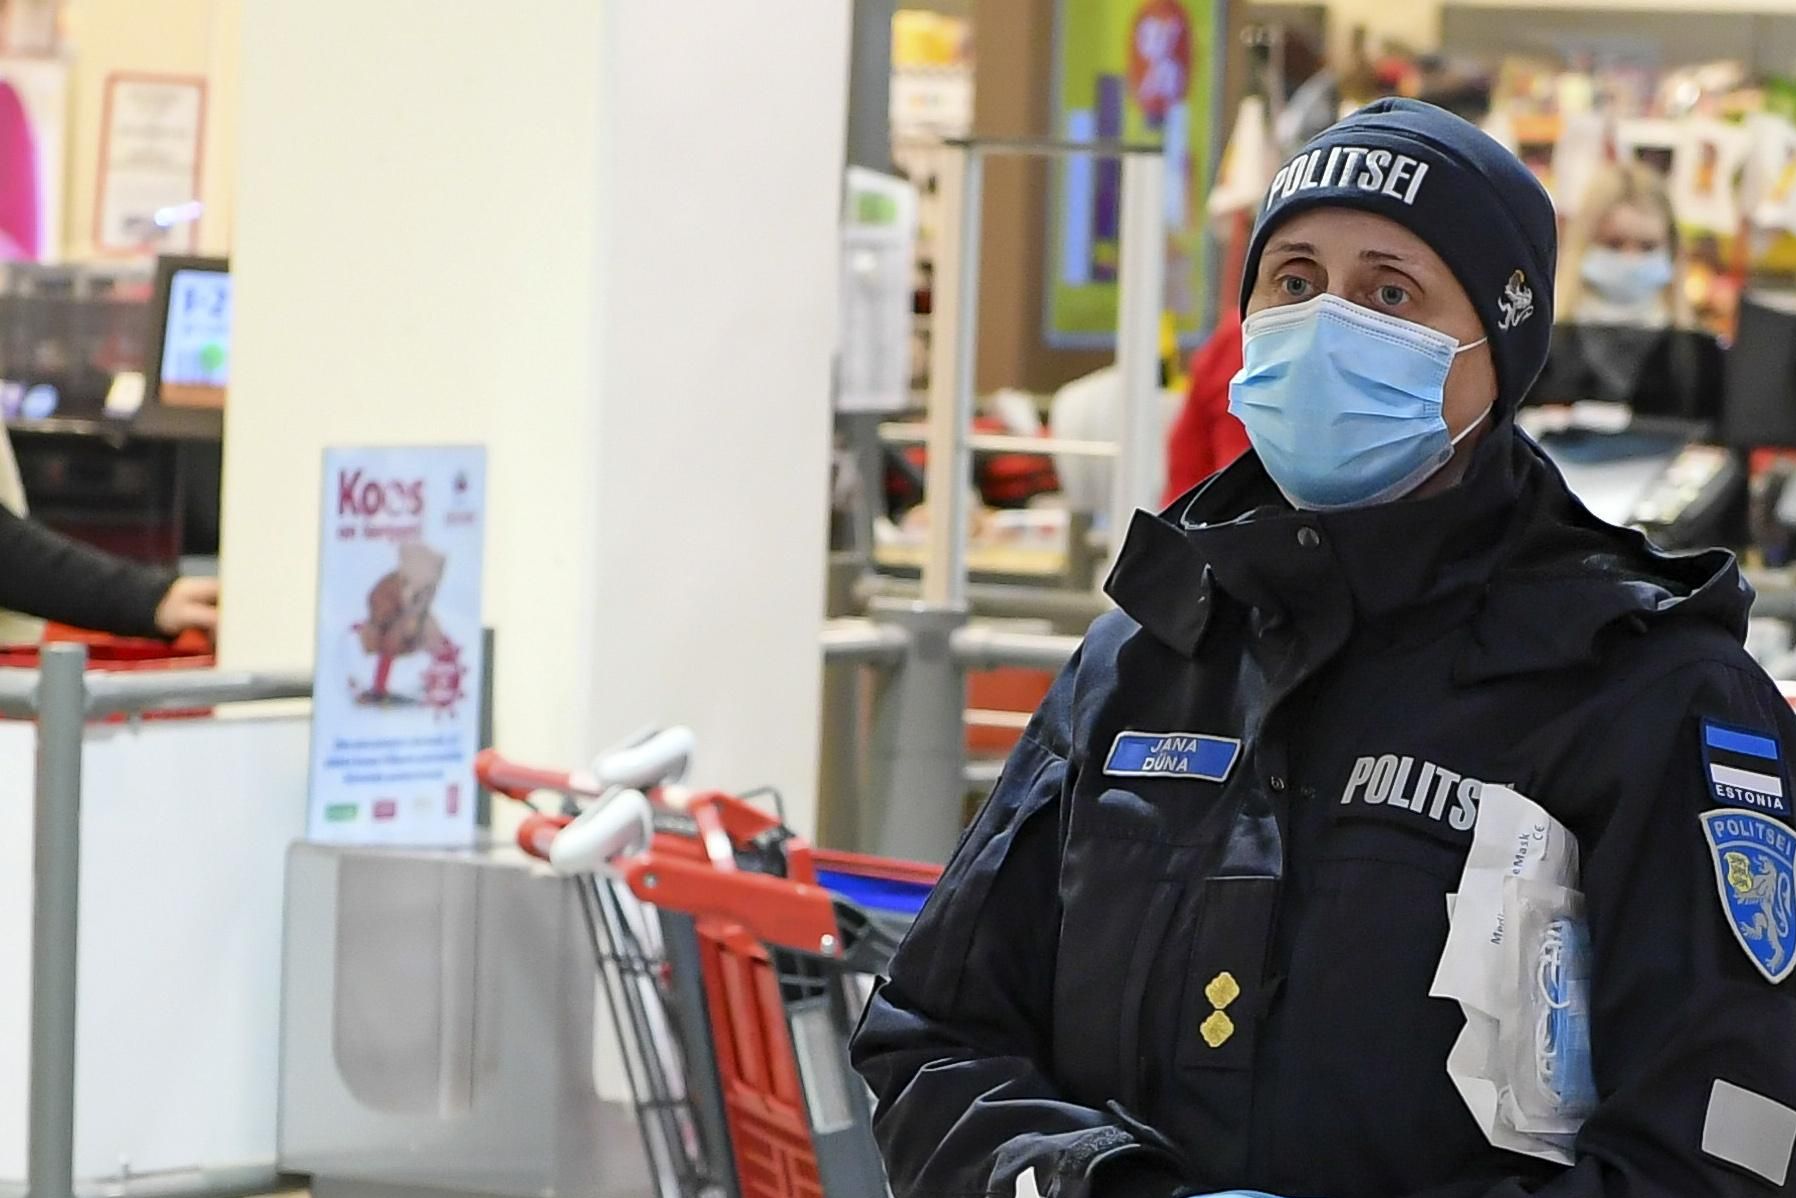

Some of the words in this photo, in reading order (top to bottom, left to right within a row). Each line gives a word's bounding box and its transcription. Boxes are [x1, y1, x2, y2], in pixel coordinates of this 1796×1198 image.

[1266, 146, 1430, 211] POLITSEI
[1150, 738, 1198, 753] JANA
[1340, 754, 1515, 831] POLITS
[1716, 784, 1784, 810] ESTONIA
[1713, 819, 1793, 856] POLITSEI
